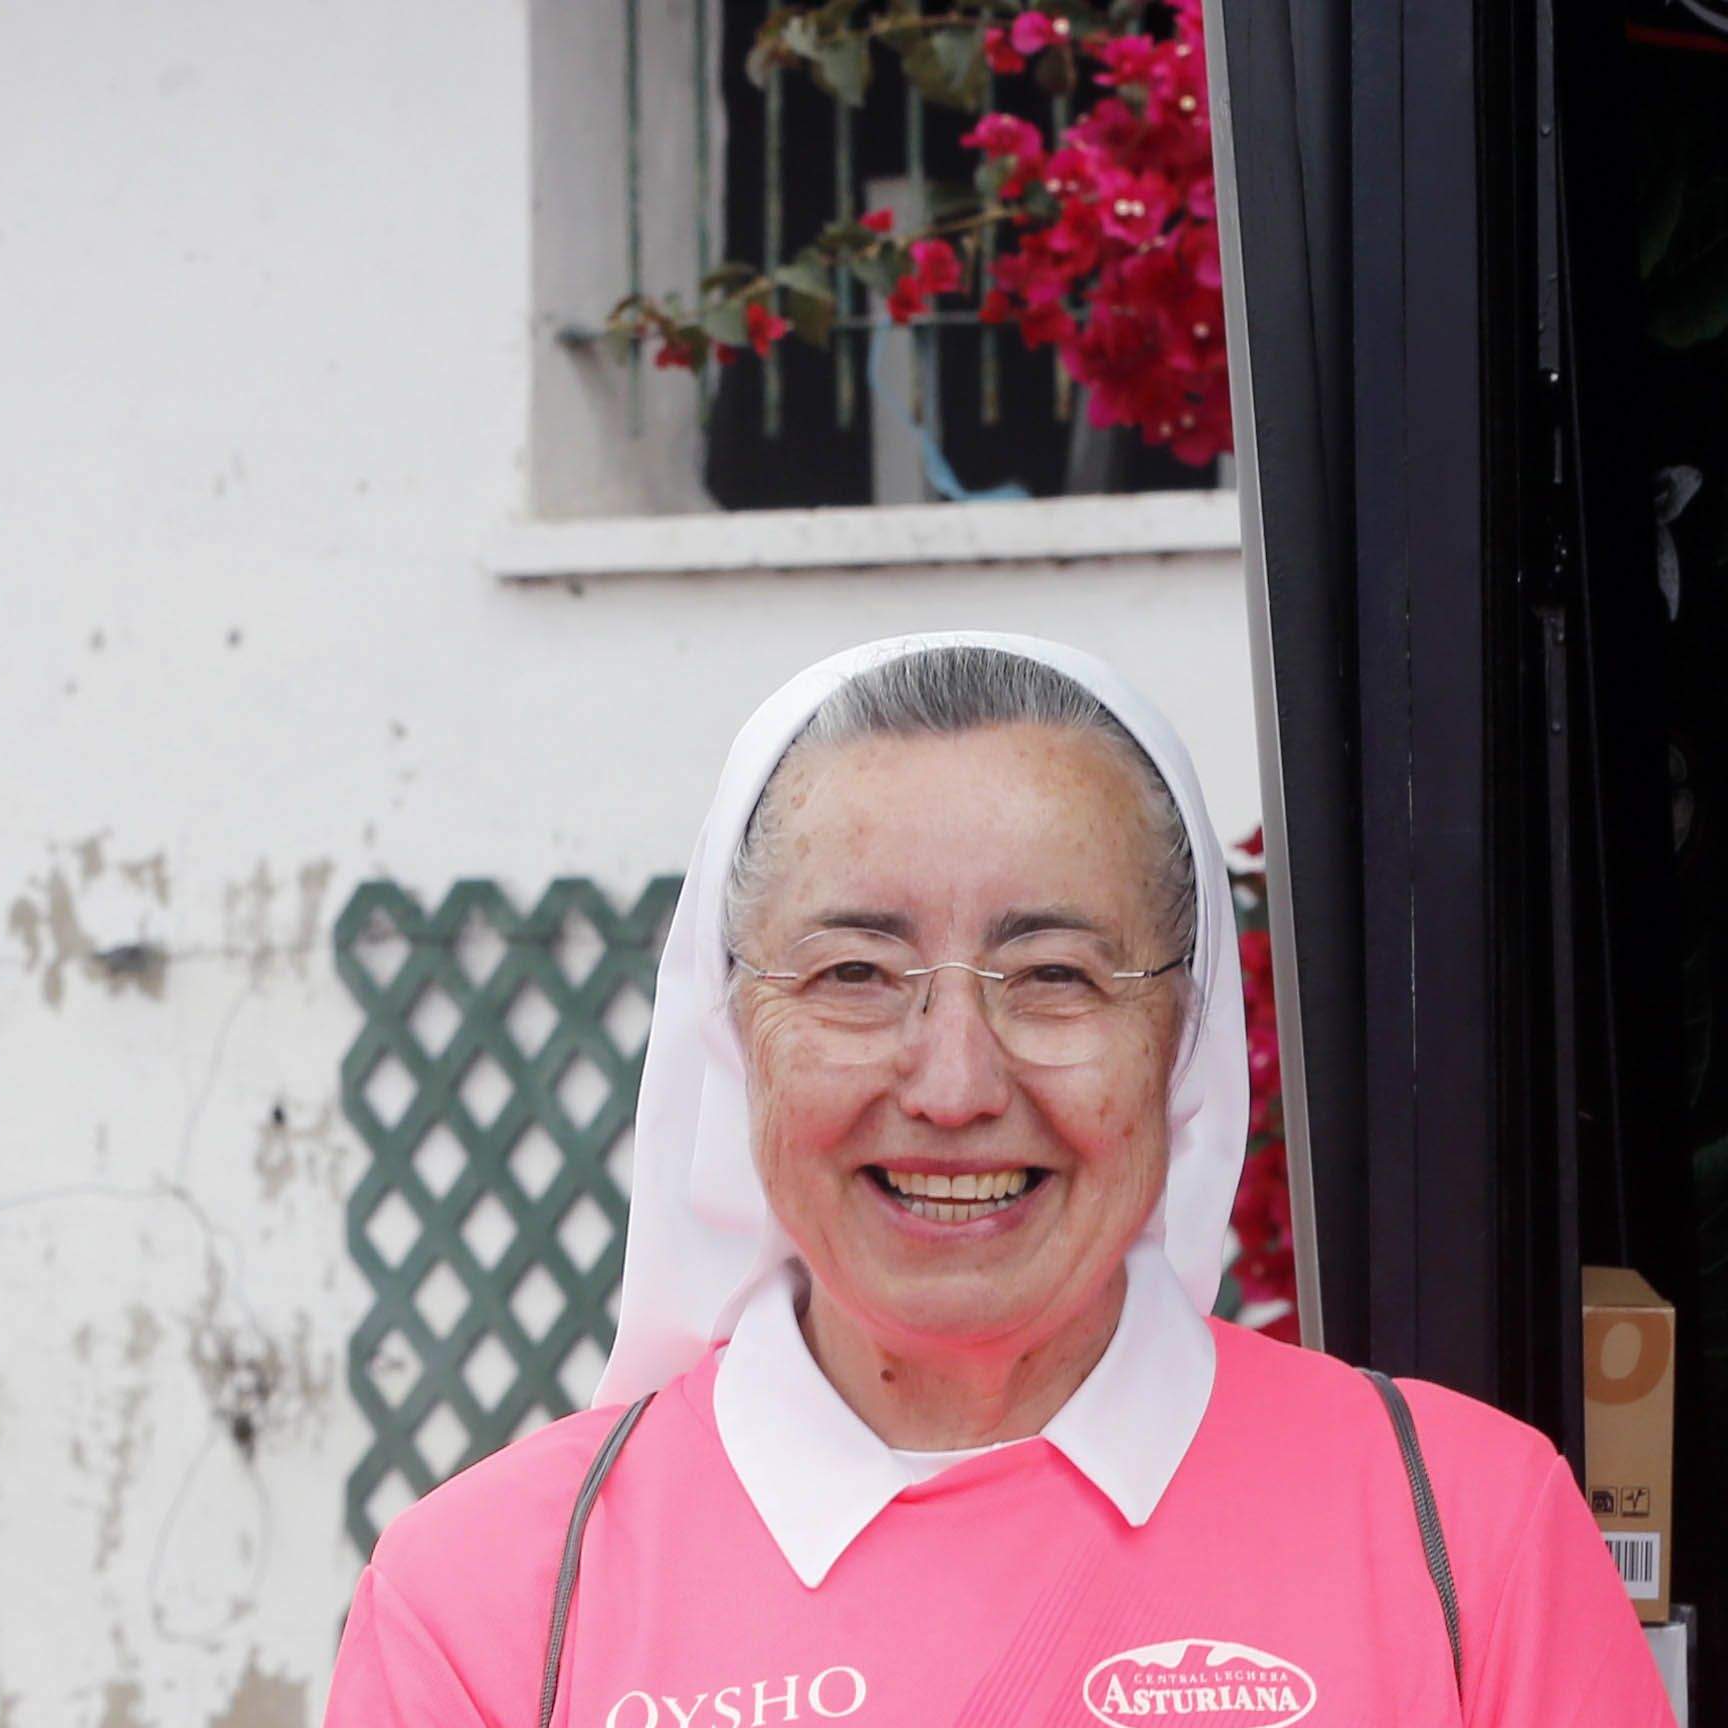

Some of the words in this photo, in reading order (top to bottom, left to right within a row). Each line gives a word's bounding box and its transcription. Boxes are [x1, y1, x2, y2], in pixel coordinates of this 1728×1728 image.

[1134, 1672, 1208, 1686] CENTRAL
[1215, 1669, 1289, 1682] LECHERA
[1102, 1673, 1300, 1715] ASTURIANA
